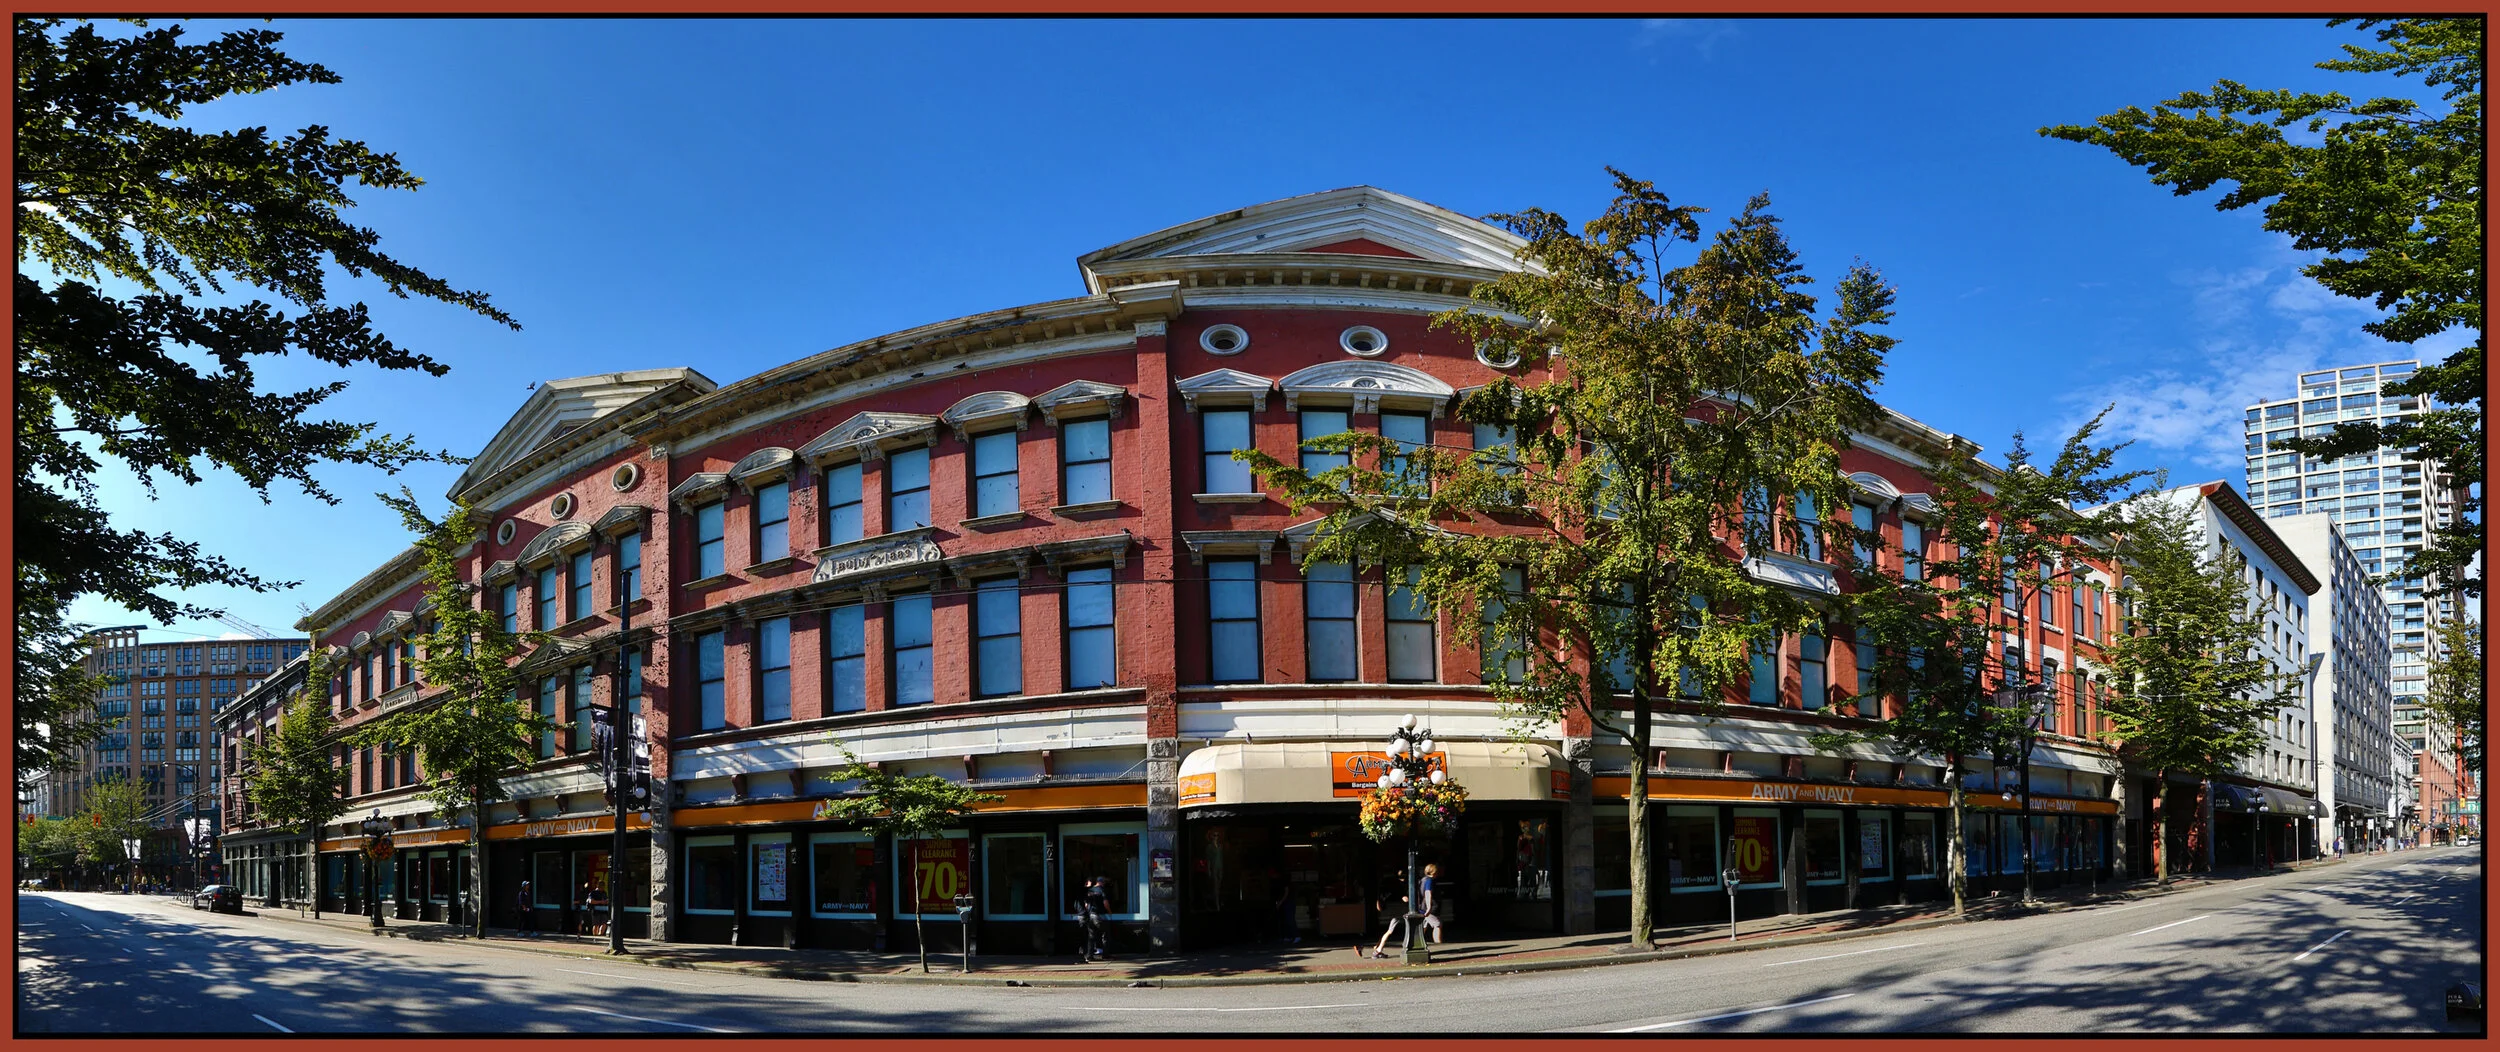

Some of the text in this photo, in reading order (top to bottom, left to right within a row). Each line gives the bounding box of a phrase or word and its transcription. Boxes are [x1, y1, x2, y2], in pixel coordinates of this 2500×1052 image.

[1751, 783, 1855, 802] ARMY AND NAVY
[2029, 799, 2047, 810] RMY
[2056, 800, 2077, 811] NAVY
[525, 822, 556, 836] ARMY
[567, 818, 599, 833] NAVY
[394, 835, 413, 845] ARMY
[419, 832, 438, 843] NAVY
[925, 840, 953, 849] SUMMER
[921, 849, 957, 859] CLEARANCE
[918, 861, 958, 900] 70
